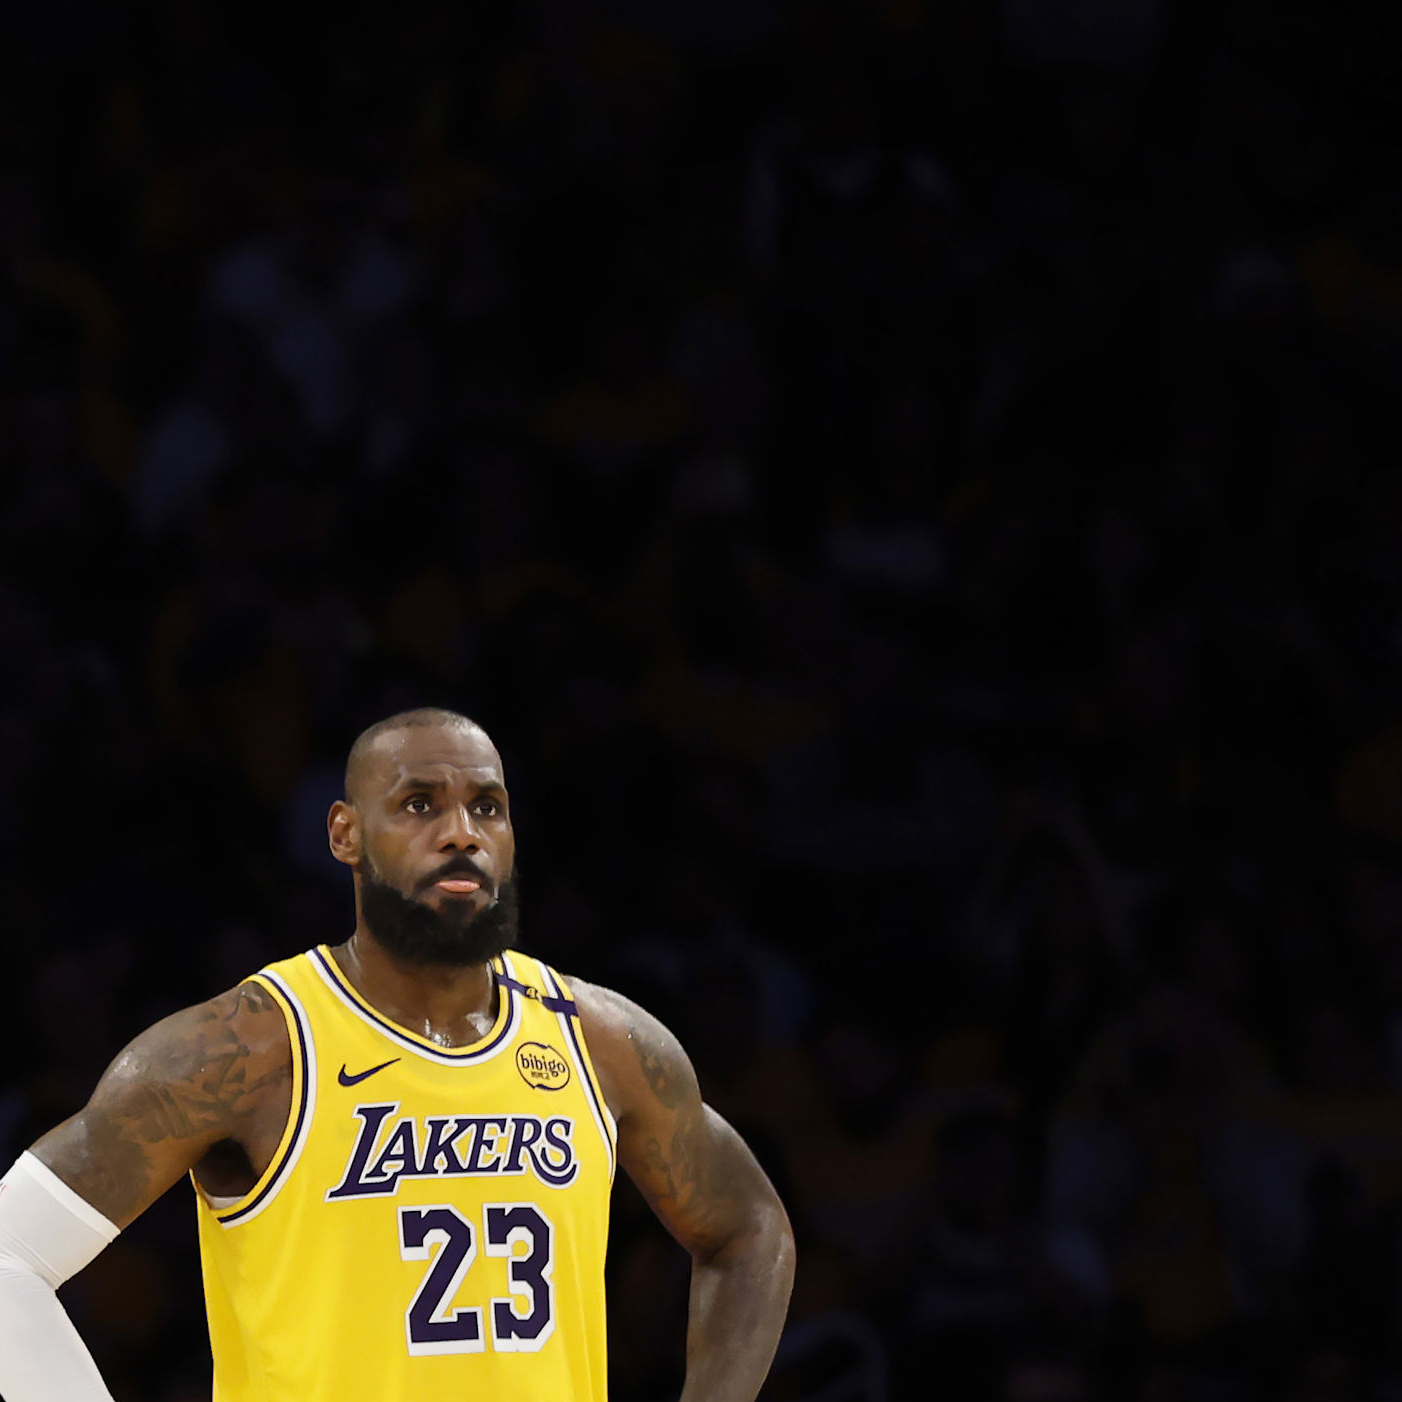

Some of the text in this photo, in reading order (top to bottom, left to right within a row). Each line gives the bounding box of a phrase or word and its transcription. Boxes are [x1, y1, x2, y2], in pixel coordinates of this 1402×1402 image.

[520, 1053, 566, 1077] bibigo
[324, 1101, 579, 1202] LAKERS
[397, 1202, 555, 1357] 23
